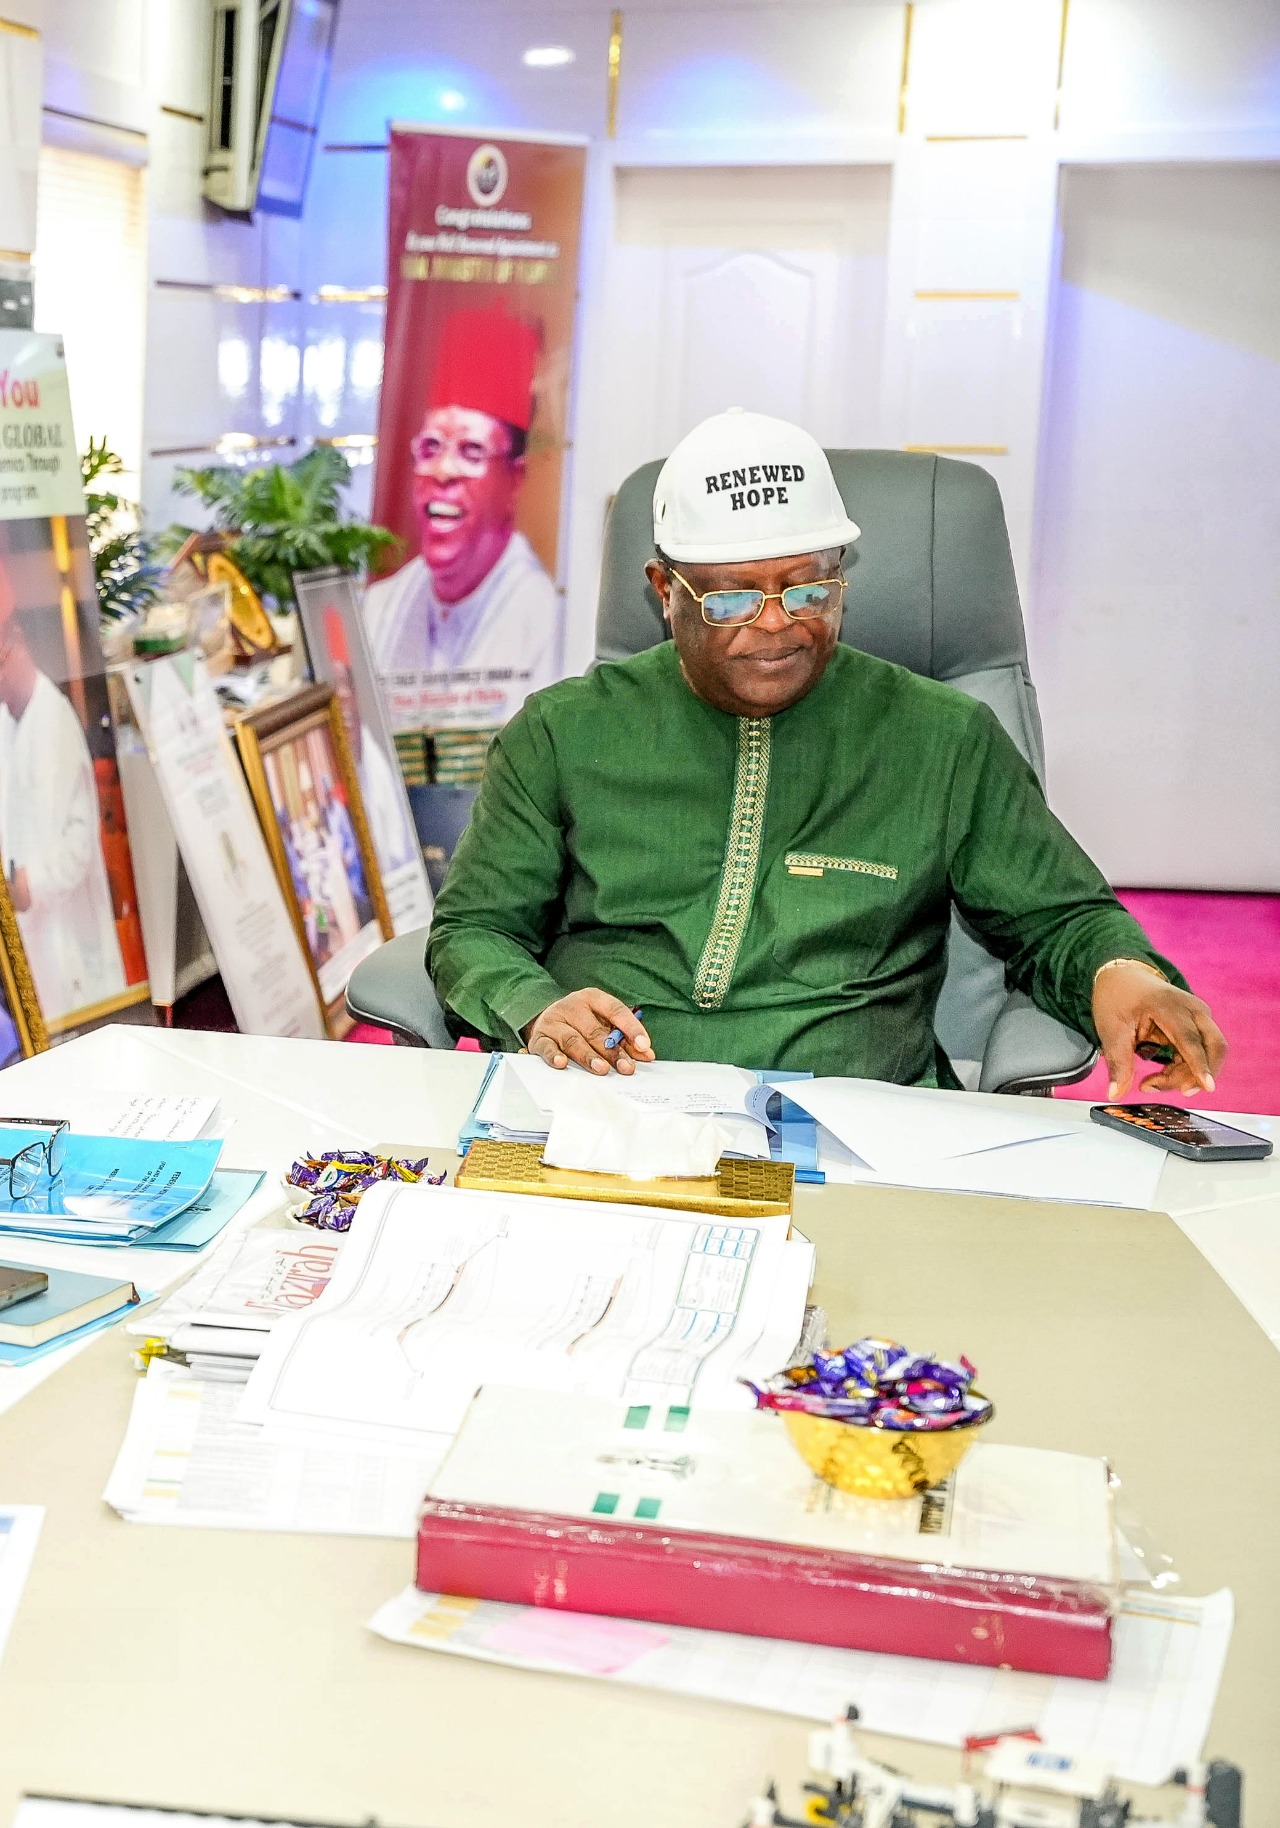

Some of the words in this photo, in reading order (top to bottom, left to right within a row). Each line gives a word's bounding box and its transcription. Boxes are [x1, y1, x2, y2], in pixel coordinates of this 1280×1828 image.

[2, 423, 65, 449] GLOBAL
[705, 465, 805, 494] RENEWED
[730, 487, 789, 511] HOPE
